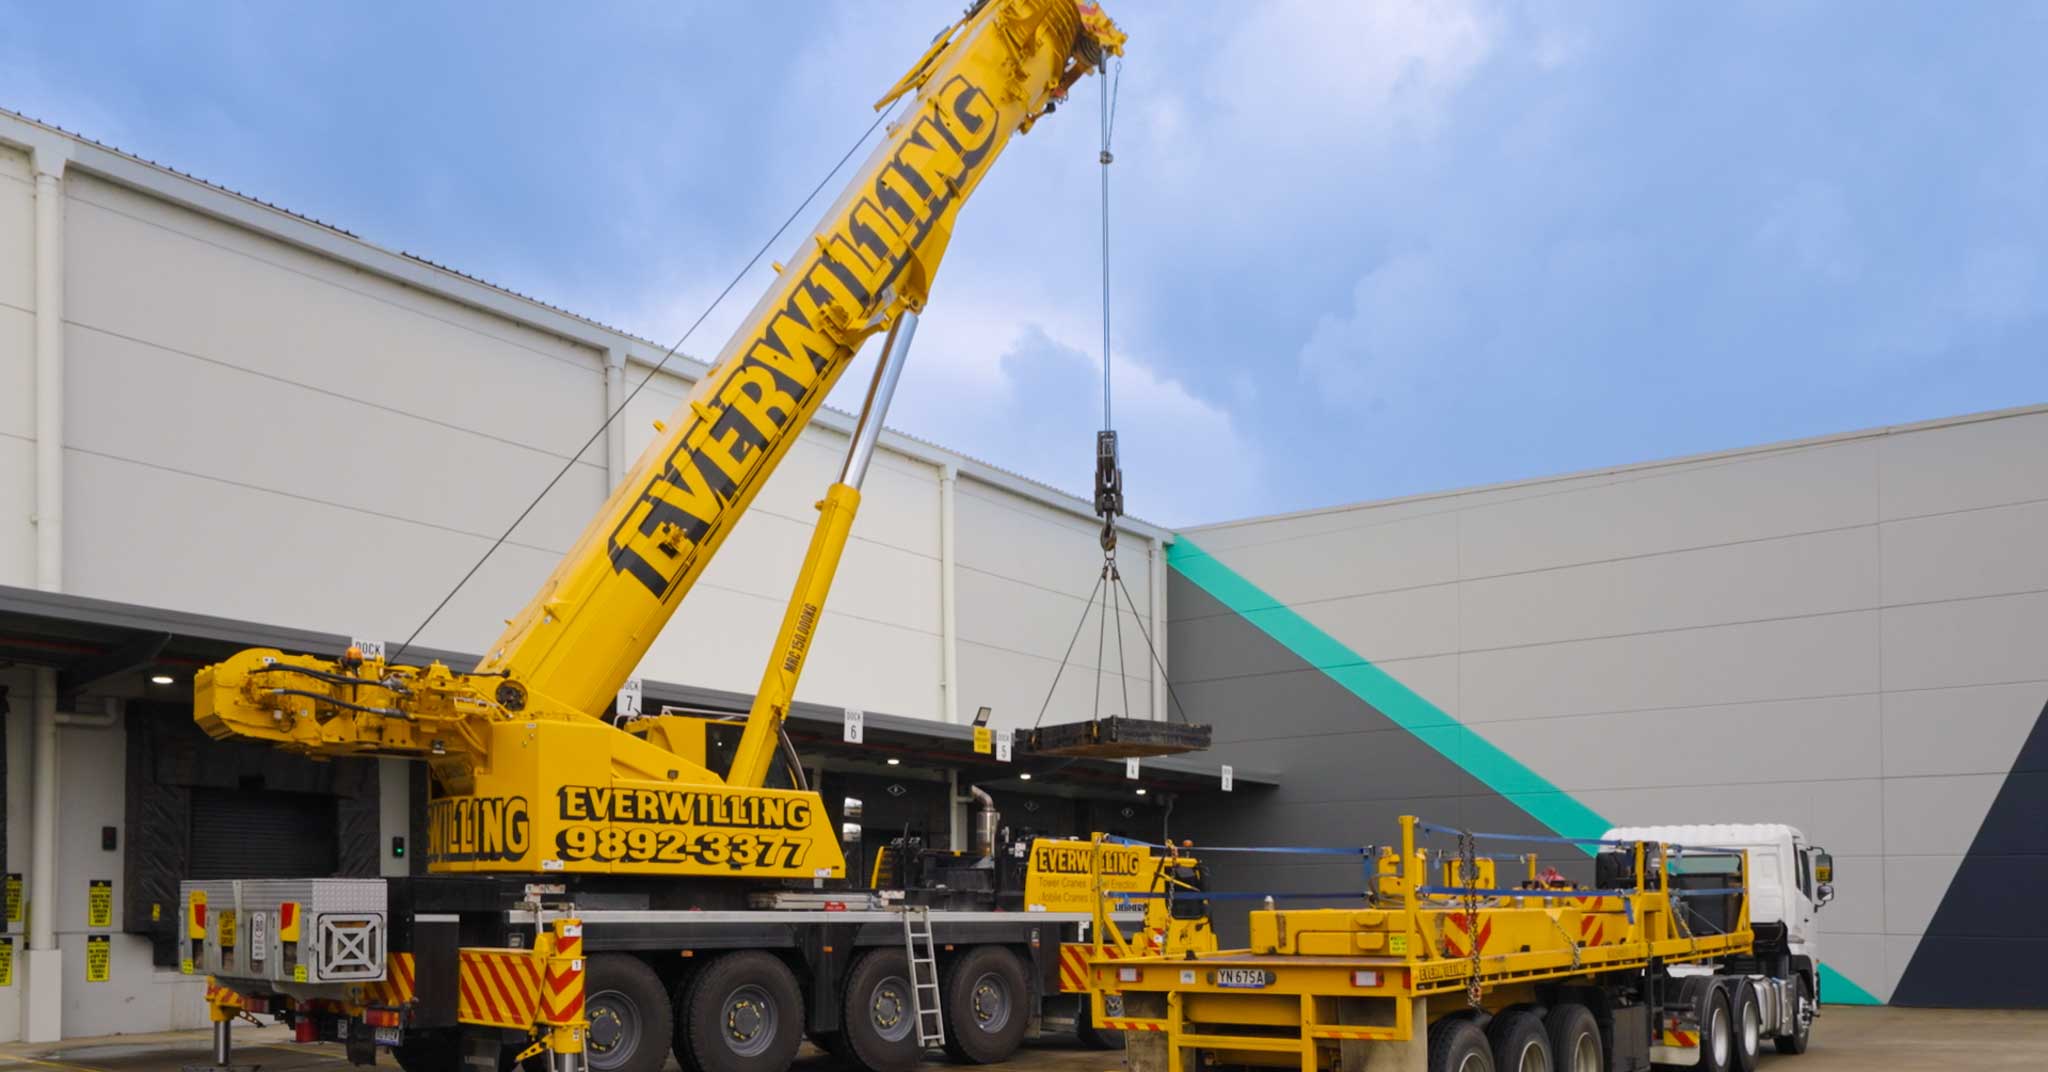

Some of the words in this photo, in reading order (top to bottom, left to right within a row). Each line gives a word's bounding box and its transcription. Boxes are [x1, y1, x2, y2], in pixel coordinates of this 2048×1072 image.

[608, 75, 999, 600] EVERWILLING
[626, 695, 633, 711] 7
[850, 725, 857, 740] 6
[557, 785, 812, 829] EVERWILLING
[556, 826, 812, 869] 9892-3377
[1036, 848, 1139, 876] EVERWLING
[1115, 902, 1147, 913] LIEBHER
[1219, 970, 1233, 983] YN
